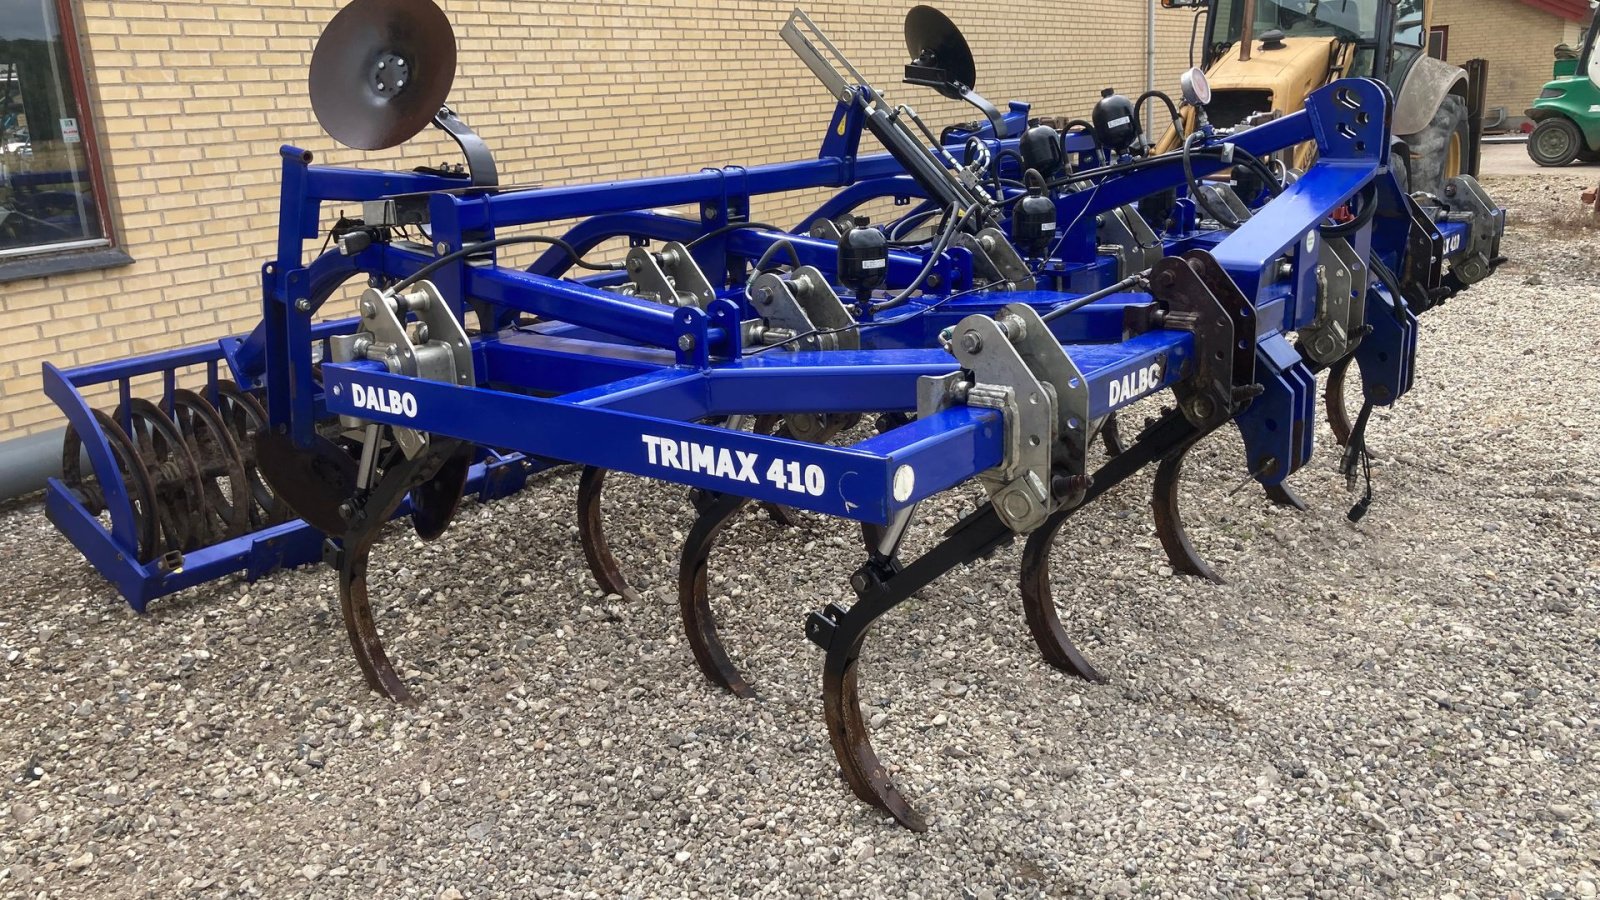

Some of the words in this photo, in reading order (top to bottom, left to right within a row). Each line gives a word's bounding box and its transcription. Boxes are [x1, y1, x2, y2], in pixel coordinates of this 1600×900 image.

[351, 383, 418, 418] DALBO
[641, 434, 760, 484] TRIMAX
[766, 458, 825, 496] 410
